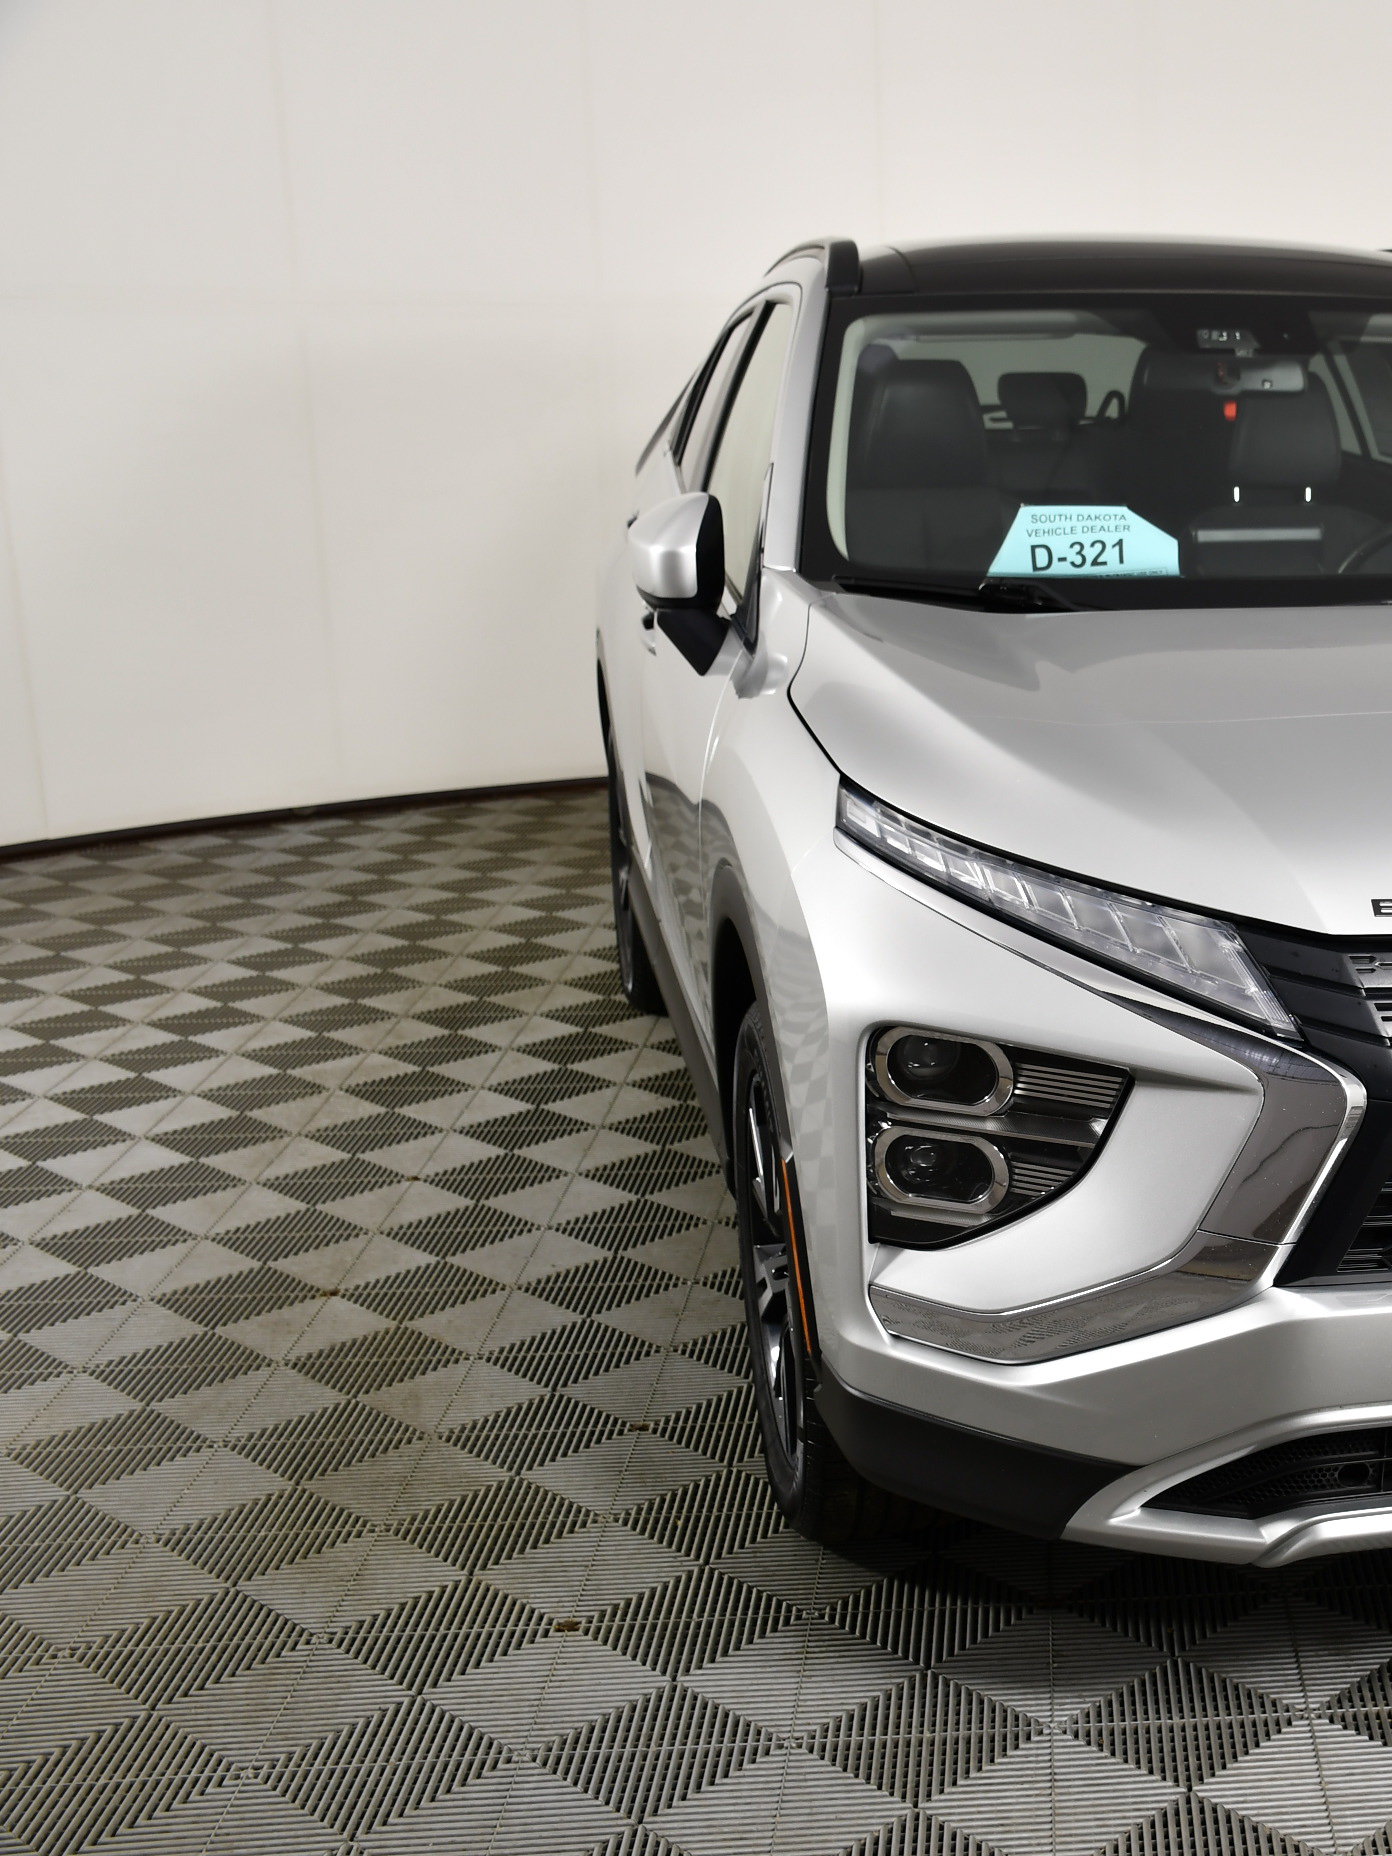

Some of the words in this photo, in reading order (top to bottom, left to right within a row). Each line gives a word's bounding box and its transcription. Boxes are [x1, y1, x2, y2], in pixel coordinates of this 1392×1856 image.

[1031, 514, 1072, 524] SOUTH
[1077, 514, 1127, 522] DAKOTA
[1026, 526, 1077, 538] VEHICLE
[1081, 525, 1131, 534] DEALER
[1030, 538, 1125, 572] D-321
